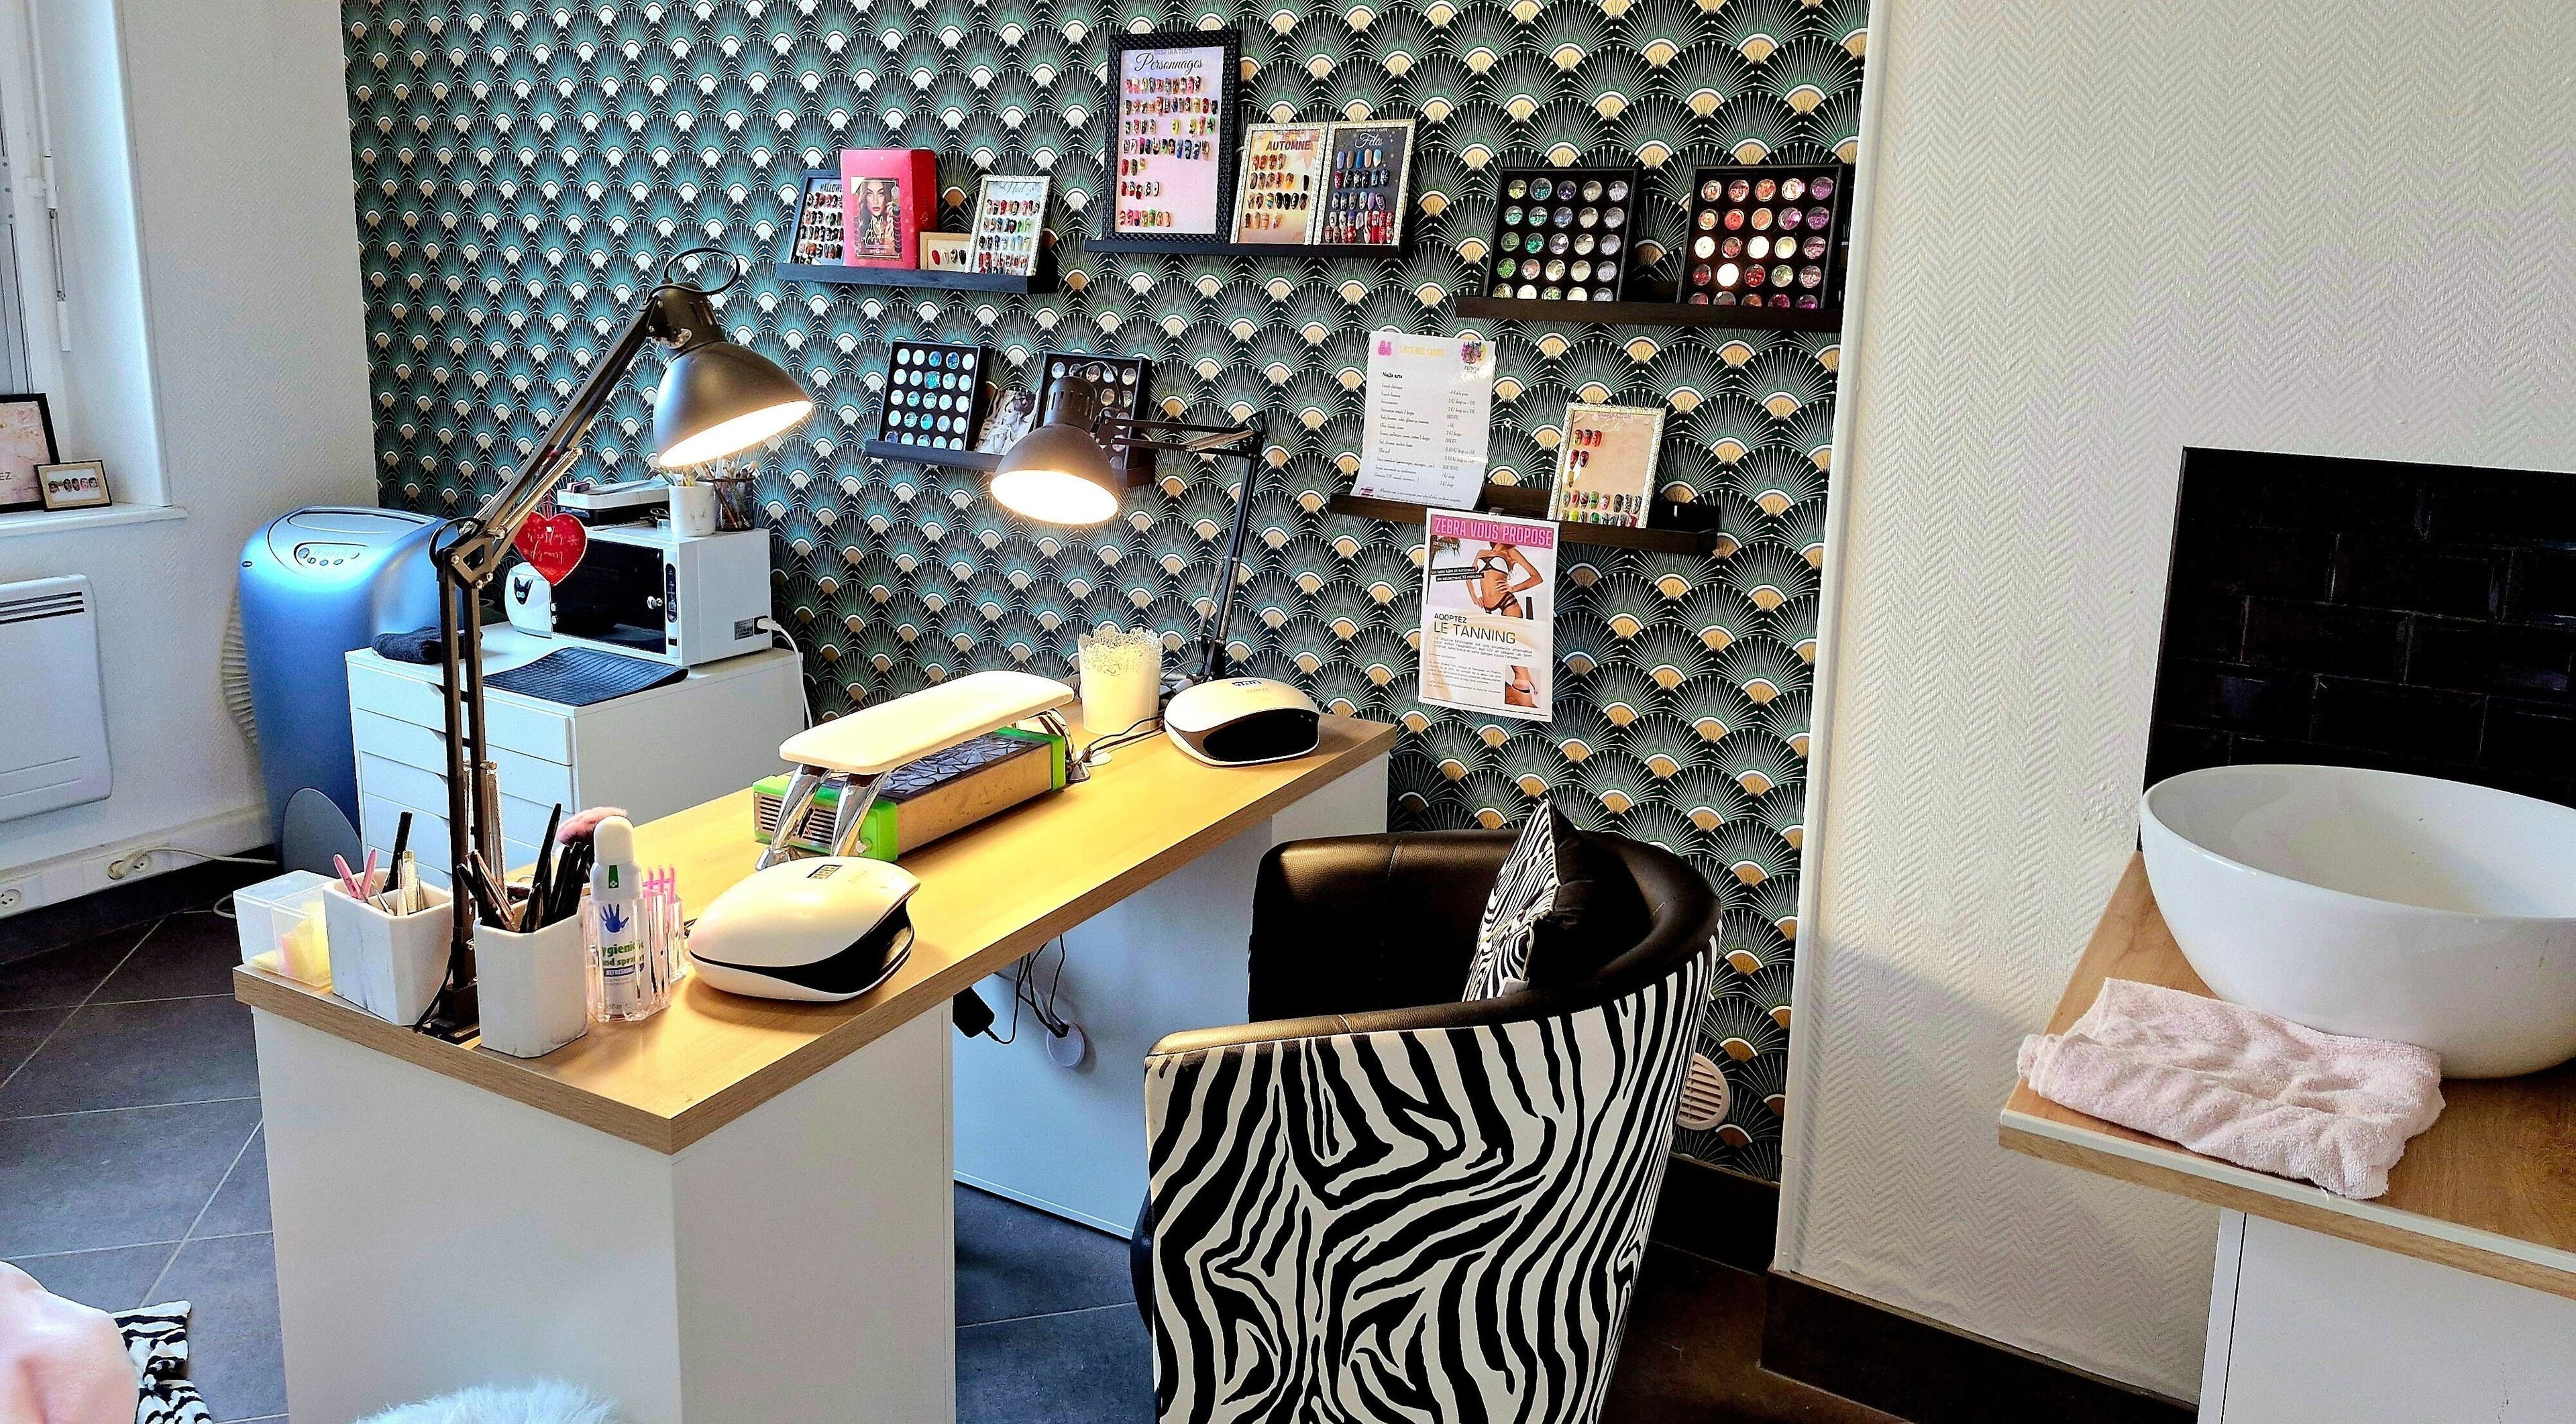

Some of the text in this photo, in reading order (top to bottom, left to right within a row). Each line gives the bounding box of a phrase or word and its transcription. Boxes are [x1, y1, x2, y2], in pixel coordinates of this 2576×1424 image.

[1134, 52, 1203, 75] Personnages
[1266, 140, 1311, 151] AUTOMNE
[1435, 517, 1553, 546] ZEBRA VOUS PROPOSE
[1434, 613, 1467, 623] ADOPTEZ
[1434, 622, 1515, 644] LE TANNING
